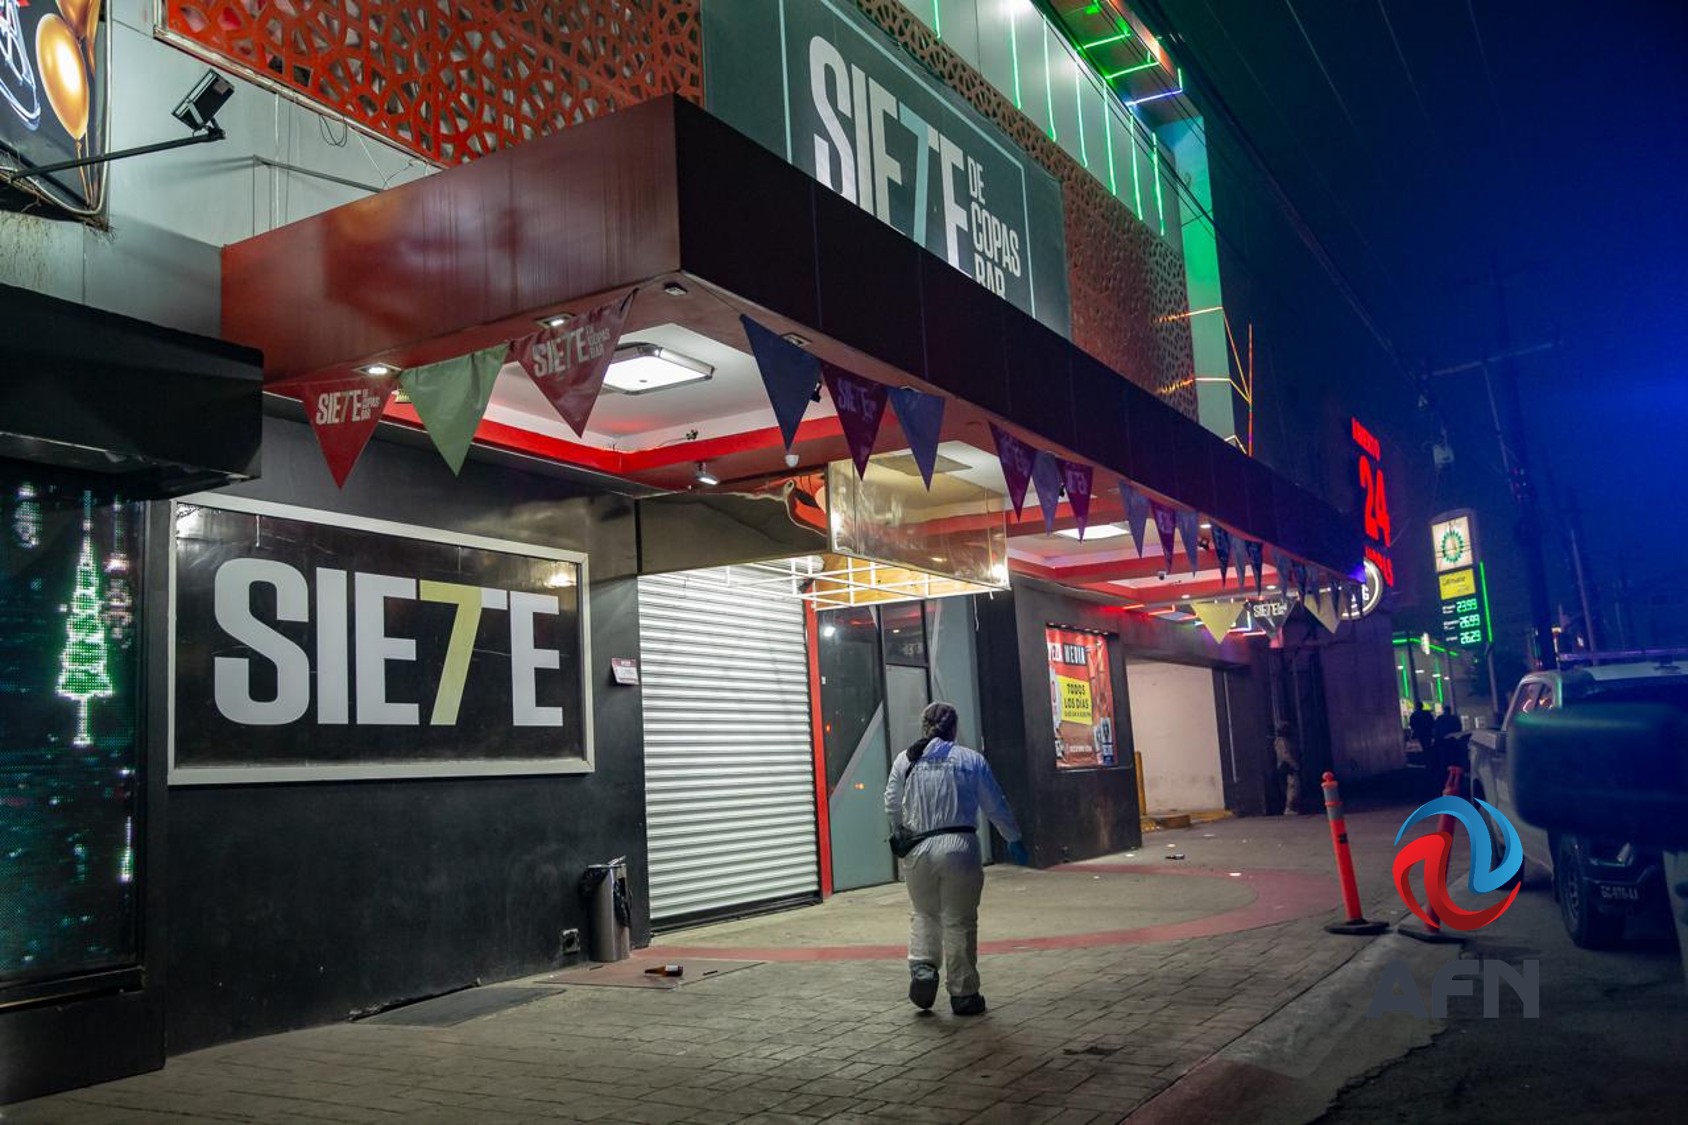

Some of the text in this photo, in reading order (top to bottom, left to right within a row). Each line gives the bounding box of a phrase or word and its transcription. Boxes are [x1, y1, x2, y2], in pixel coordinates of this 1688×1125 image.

[967, 155, 986, 205] DE
[971, 201, 1021, 277] COPAS
[1359, 455, 1391, 548] 24
